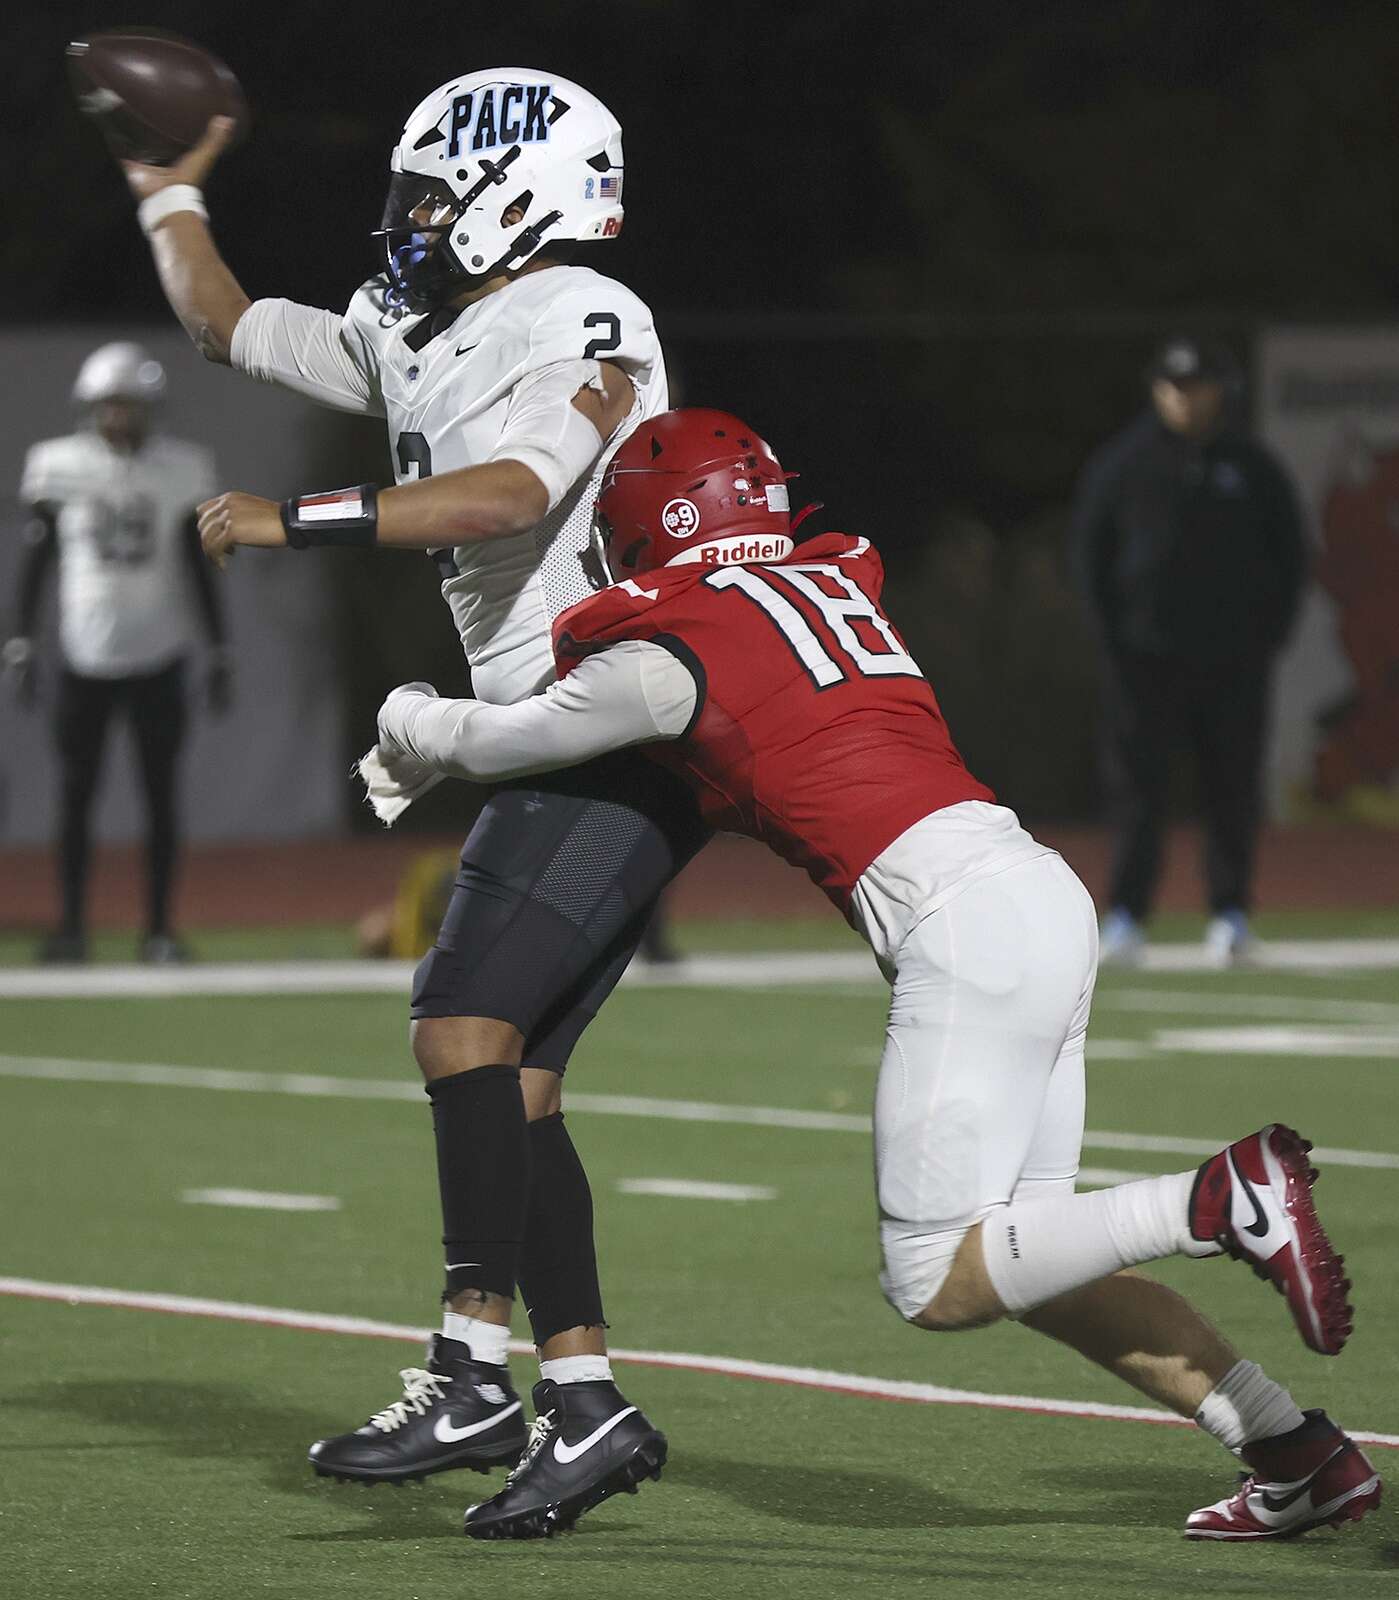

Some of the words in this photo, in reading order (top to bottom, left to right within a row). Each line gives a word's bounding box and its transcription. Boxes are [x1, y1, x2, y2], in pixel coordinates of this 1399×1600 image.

[447, 84, 553, 159] PACK
[585, 178, 594, 199] 2
[582, 312, 621, 360] 2
[701, 540, 784, 565] Riddell
[702, 564, 926, 692] 18
